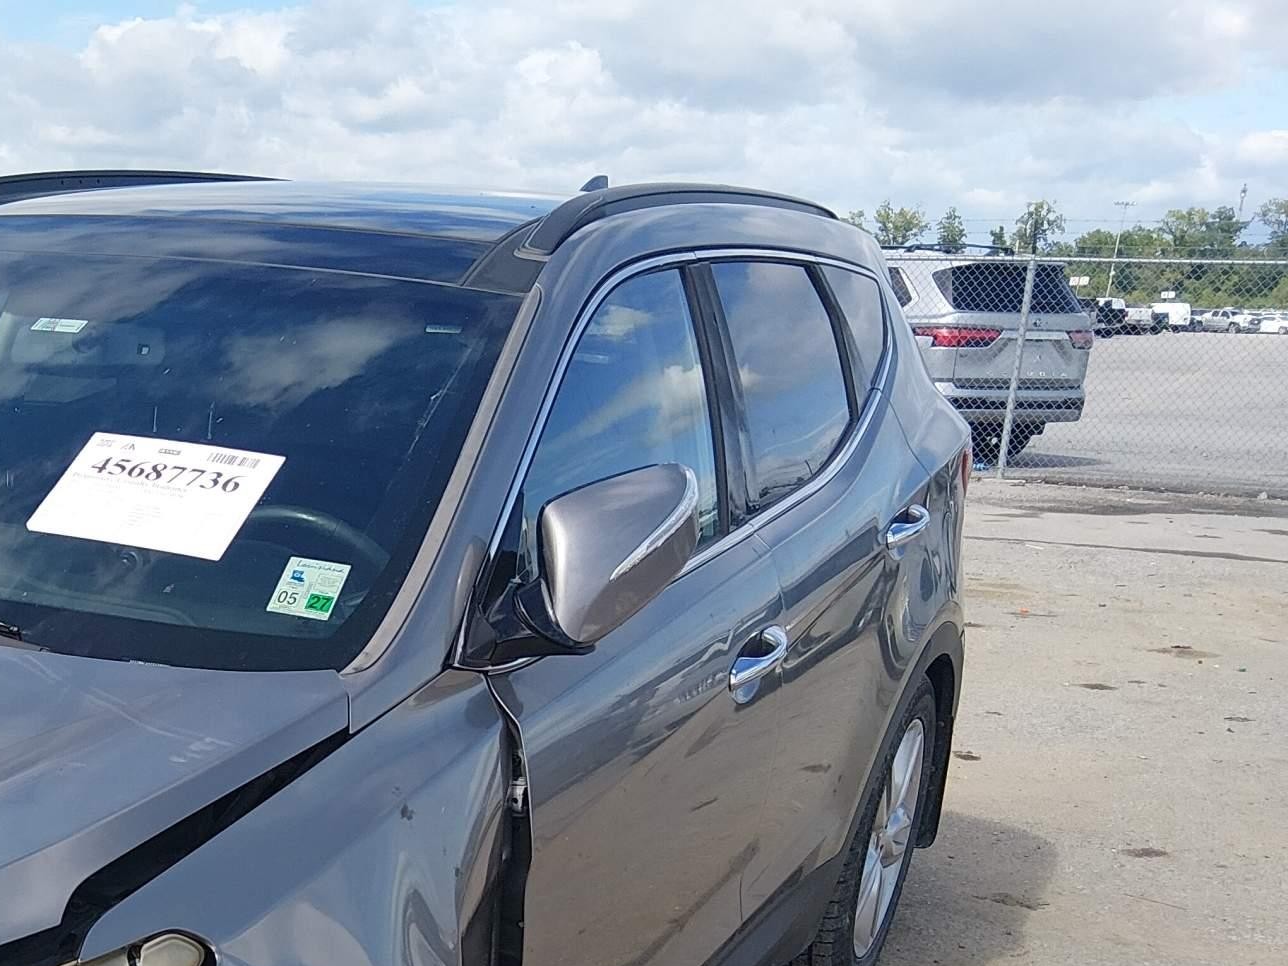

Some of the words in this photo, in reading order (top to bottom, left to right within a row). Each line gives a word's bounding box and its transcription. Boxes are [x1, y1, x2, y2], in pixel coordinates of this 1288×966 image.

[91, 456, 248, 493] 45687736
[277, 590, 299, 605] 05
[309, 595, 333, 612] 27
